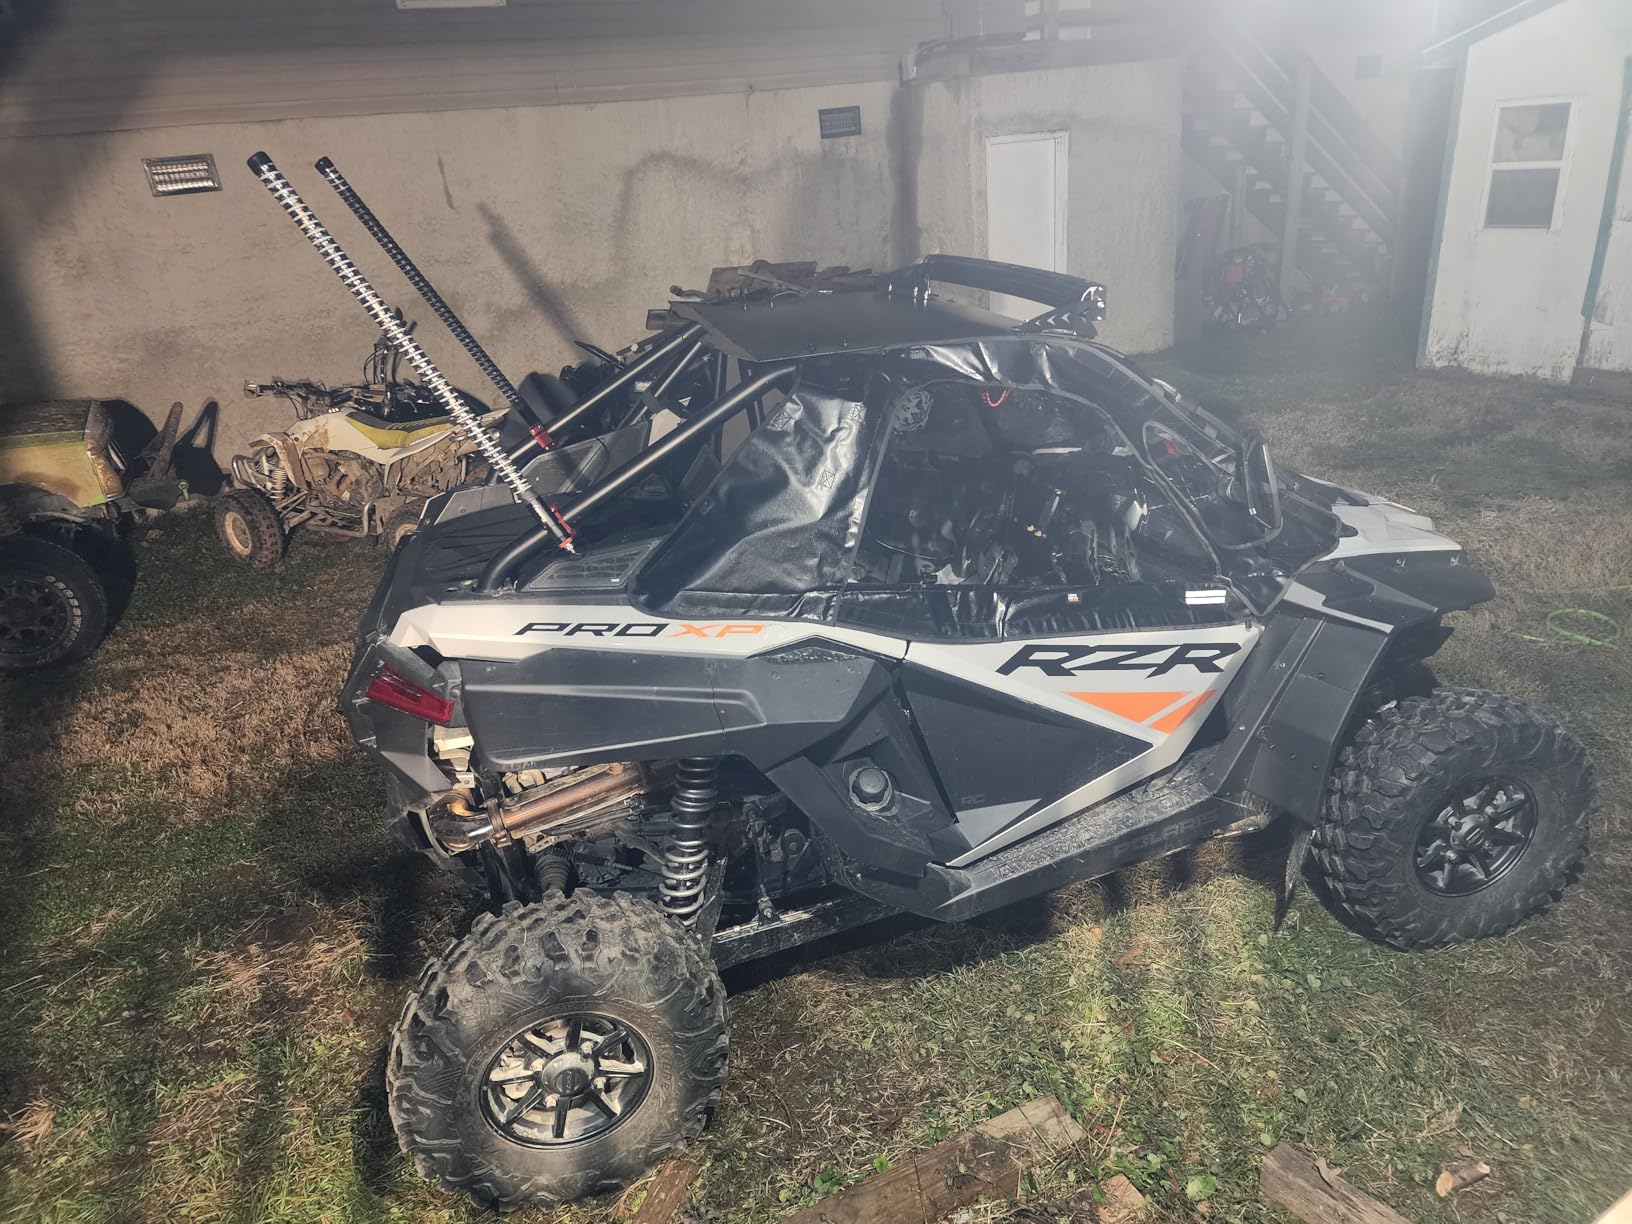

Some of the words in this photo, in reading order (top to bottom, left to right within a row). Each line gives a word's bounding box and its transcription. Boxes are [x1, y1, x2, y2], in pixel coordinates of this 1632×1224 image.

[44, 575, 82, 648] CROSSWIND
[513, 622, 670, 638] PRO
[672, 623, 765, 639] XP
[996, 642, 1242, 679] RZR
[1112, 809, 1217, 856] POLARIS
